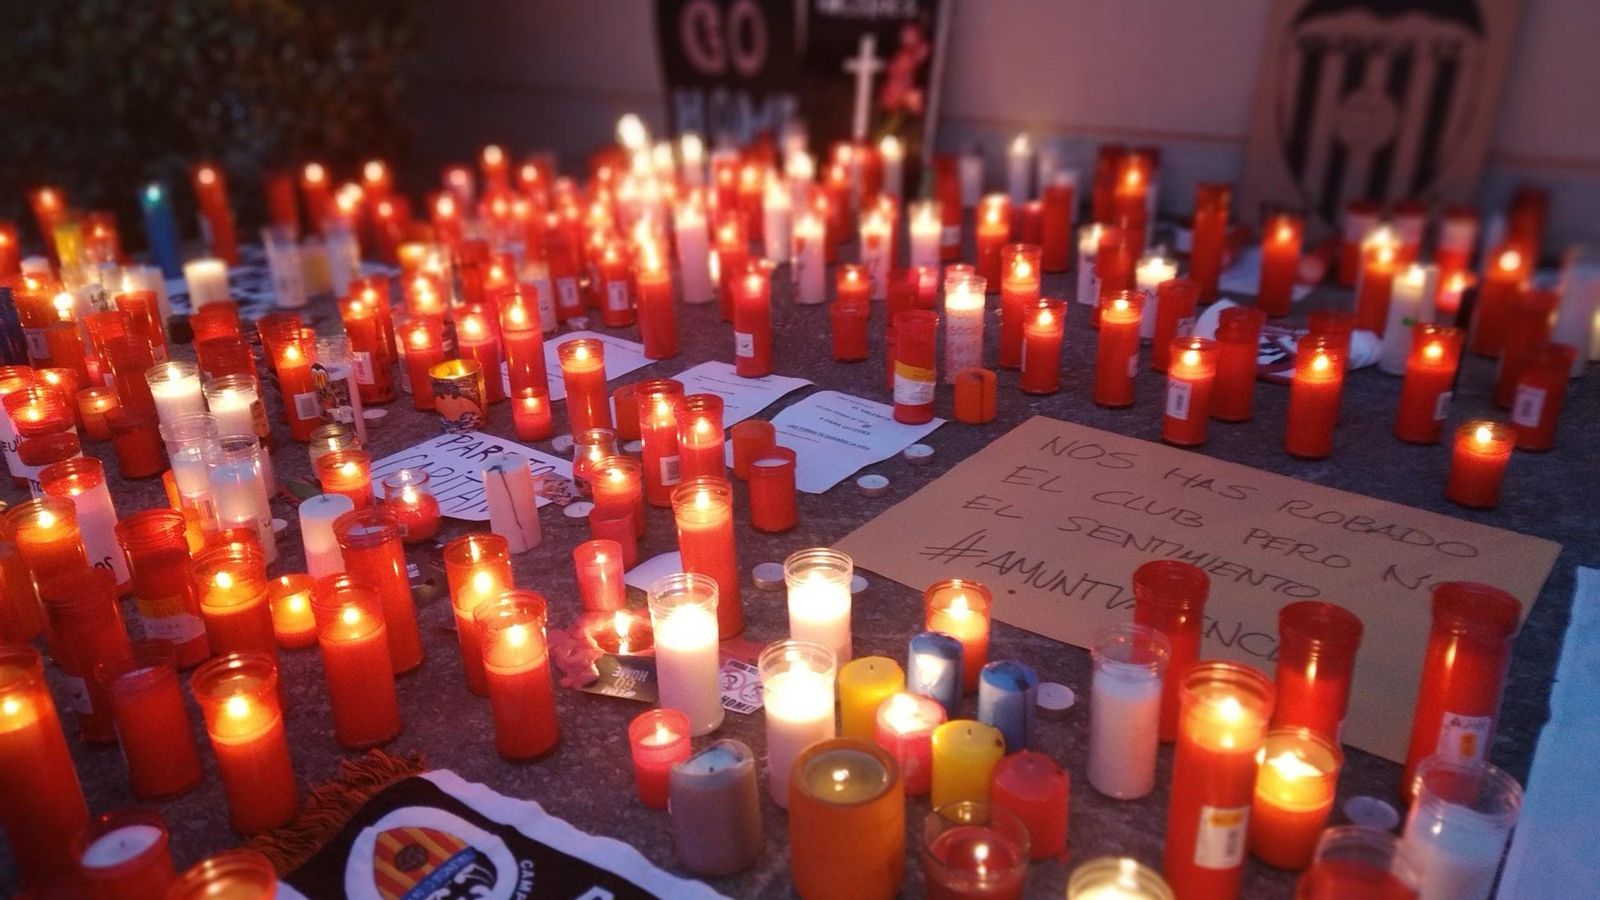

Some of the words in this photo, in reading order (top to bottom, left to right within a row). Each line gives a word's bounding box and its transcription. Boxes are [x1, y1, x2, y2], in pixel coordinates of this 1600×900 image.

[679, 0, 767, 75] GO
[961, 493, 1024, 519] EL
[1057, 515, 1321, 598] SENTIMIENTO
[1001, 464, 1064, 493] EL
[1092, 490, 1204, 528] CLUB
[1243, 527, 1351, 569] PERO
[1382, 564, 1437, 591] N
[1041, 435, 1139, 470] NOS
[1163, 467, 1258, 500] HAS
[1278, 499, 1480, 558] ROBADO
